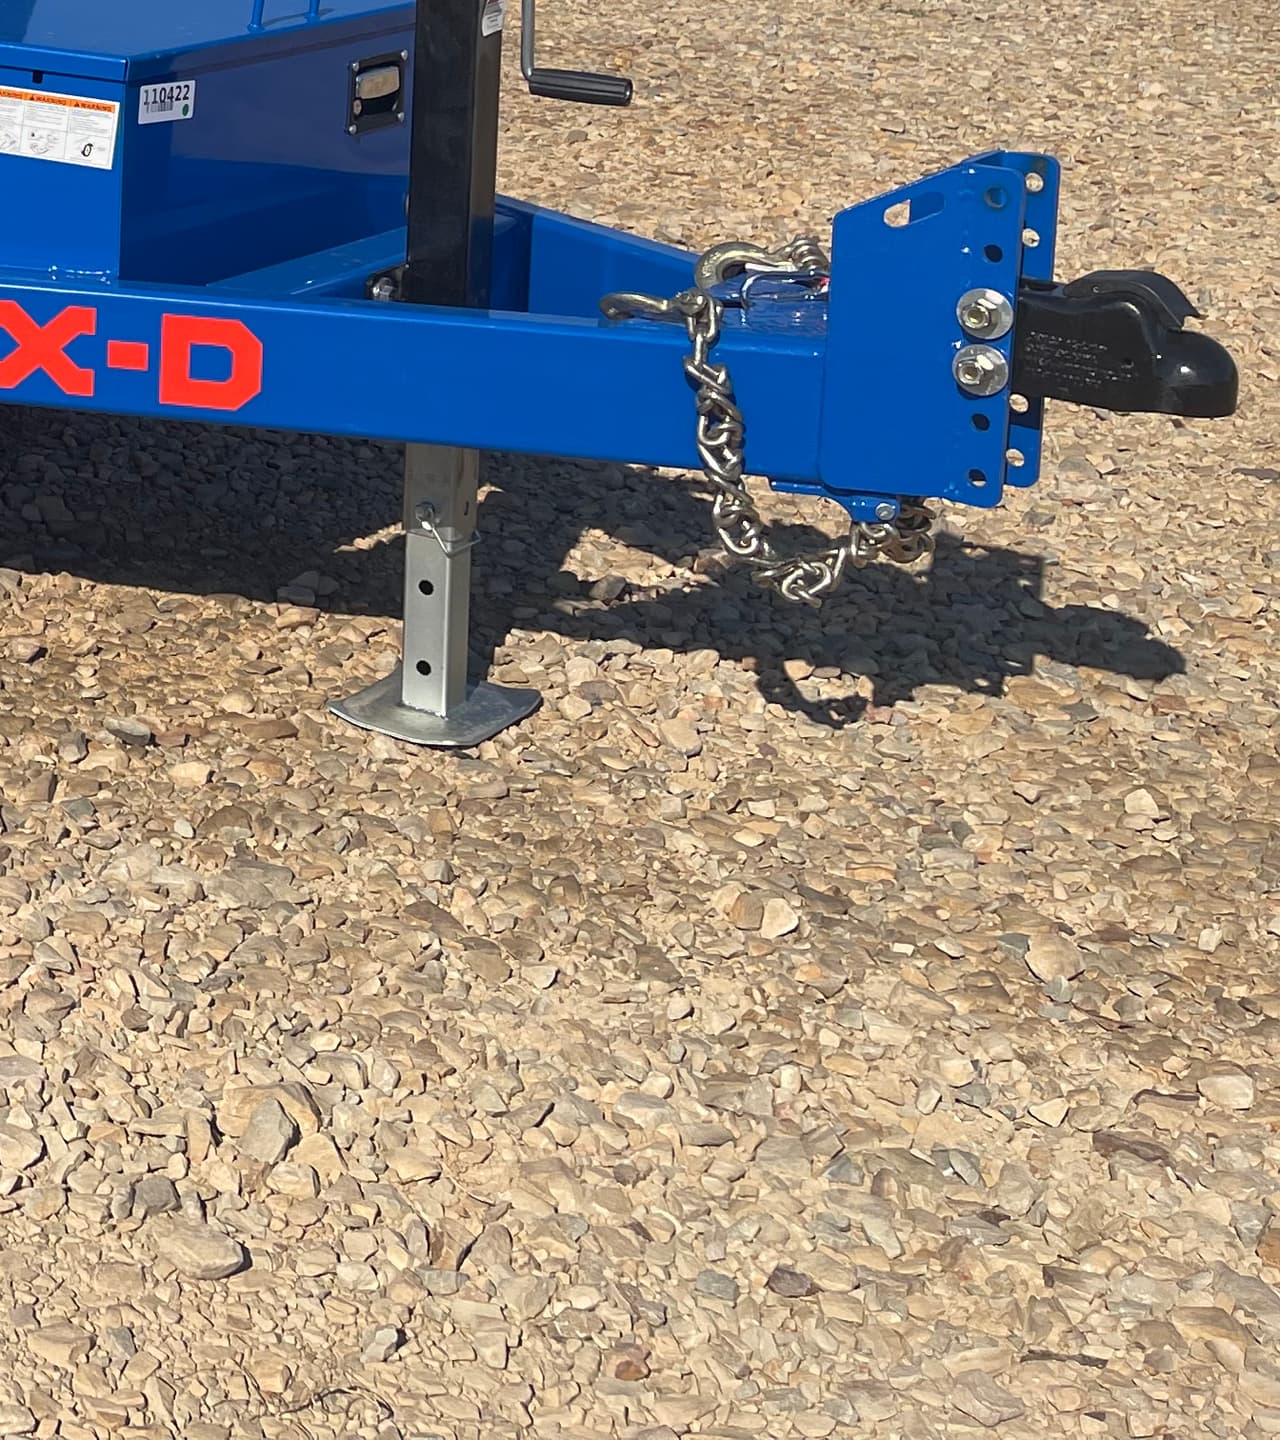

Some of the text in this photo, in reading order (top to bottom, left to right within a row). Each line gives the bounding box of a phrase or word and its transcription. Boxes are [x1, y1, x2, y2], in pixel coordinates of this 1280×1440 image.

[39, 95, 67, 106] WARNING
[143, 84, 191, 106] 110422
[79, 102, 113, 112] WARNING
